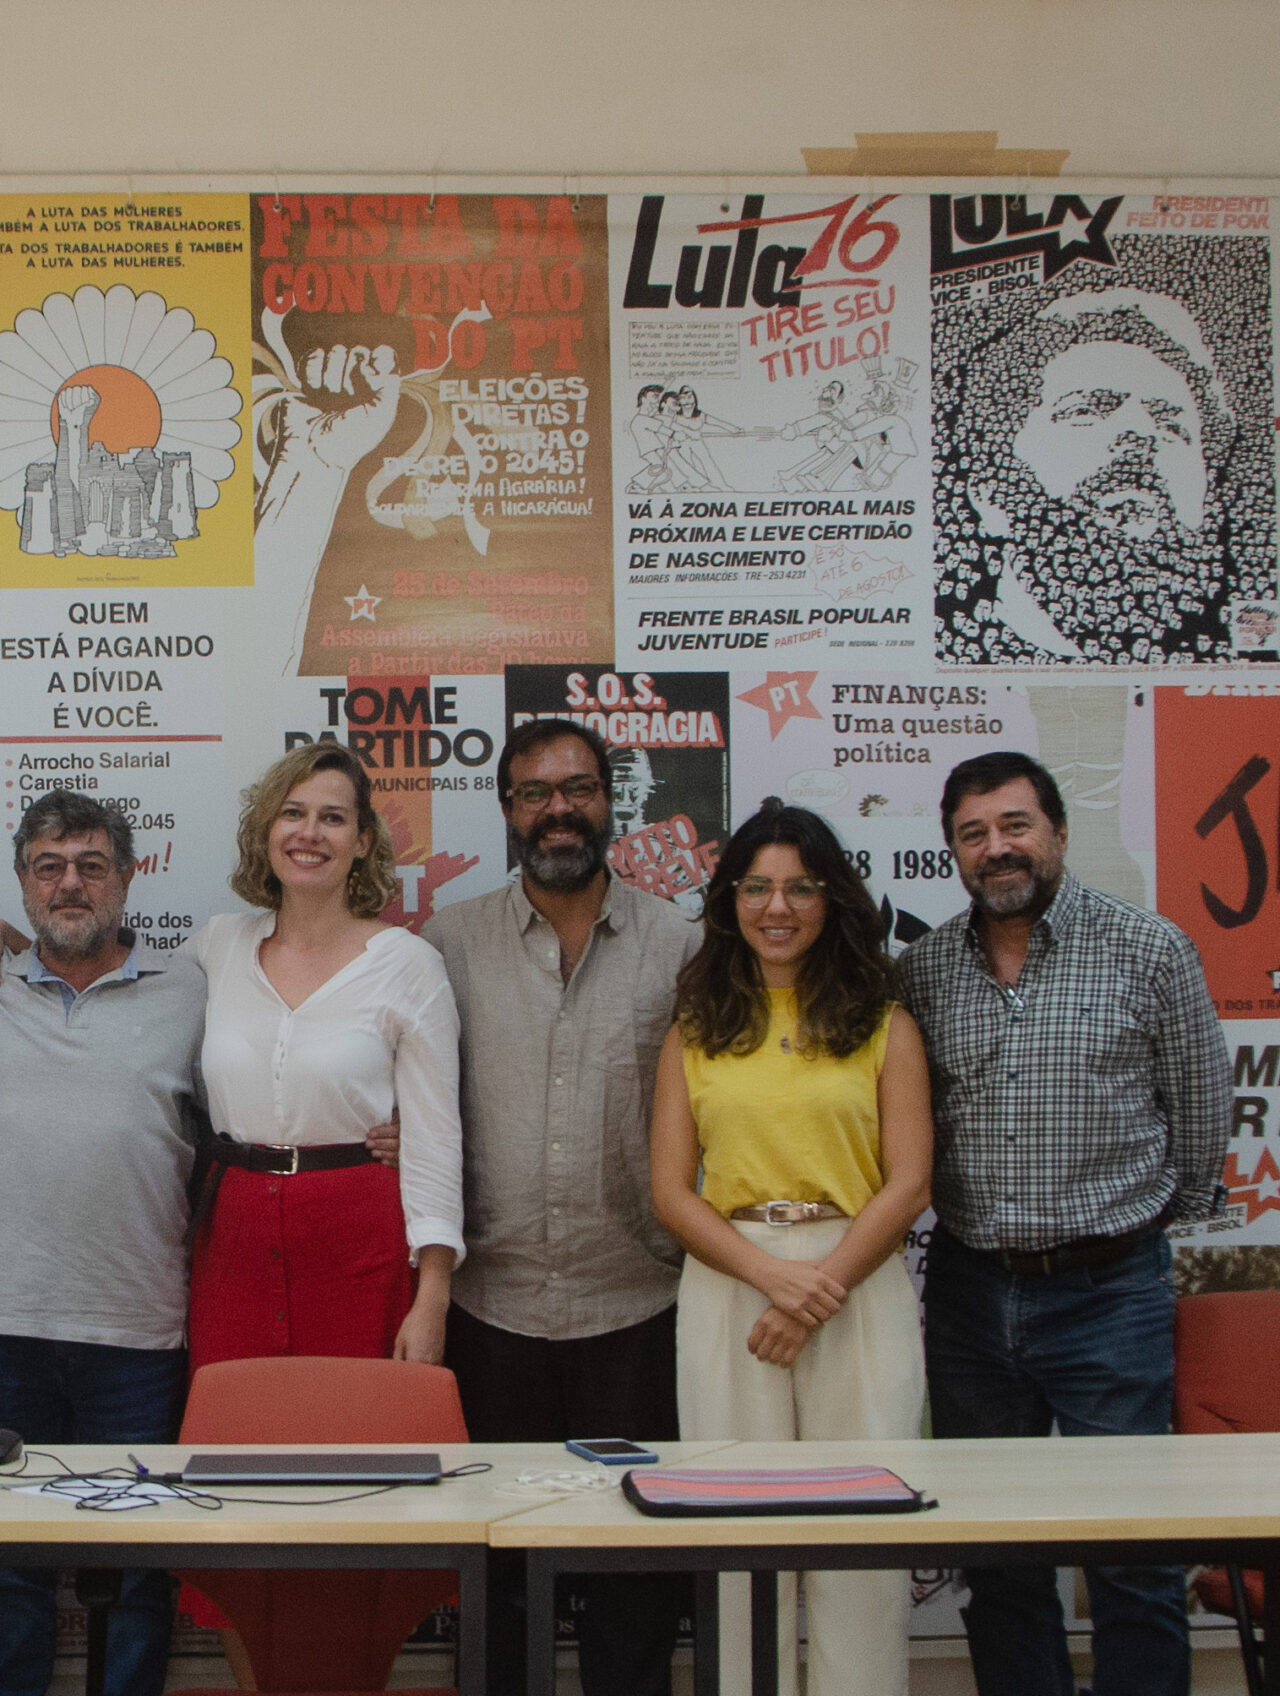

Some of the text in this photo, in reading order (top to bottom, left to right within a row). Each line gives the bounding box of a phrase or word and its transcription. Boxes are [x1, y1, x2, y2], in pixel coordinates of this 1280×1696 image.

[27, 206, 182, 218] A LUTA DAS MULHERES
[1126, 212, 1219, 229] FEITO DE
[40, 221, 49, 232] A
[54, 221, 86, 232] LUTA
[94, 220, 121, 232] DOS
[128, 220, 245, 232] TRABALHADORES.
[258, 194, 584, 257] FESTA DA
[20, 243, 48, 254] DOS
[56, 242, 169, 254] TRABALHADORES
[176, 239, 183, 253] É
[189, 240, 244, 253] TAMBÉM
[623, 195, 807, 309] Lula
[26, 256, 185, 268] A LUTA DAS MULHERES.
[930, 255, 1040, 290] PRESIDENTE
[263, 256, 585, 317] CONVENÇÃO
[930, 272, 1040, 305] VICE BISOL
[740, 285, 896, 348] TIRE SEU
[413, 317, 486, 370] DO
[510, 317, 584, 371] PT
[759, 321, 891, 383] TÍTULO!
[439, 373, 589, 403] ELEIÇÕES
[472, 429, 589, 452] CONTRA O
[505, 450, 585, 475] 2045!
[482, 502, 495, 516] A
[628, 499, 916, 519] VÁ ZONA ELEITORAL MAIS
[628, 521, 913, 543] PRÓXIMA E LEVE CERTIDÃO
[629, 550, 806, 569] DE NASCIMENTO
[431, 570, 589, 596] de Setembro
[629, 574, 670, 585] MAIORES
[69, 602, 149, 625] QUEM
[638, 608, 912, 628] FRENTE BRASIL POPULAR
[0, 632, 214, 660] ESTÁ PAGANDO
[638, 633, 769, 651] JUVENTUDE
[448, 655, 488, 673] das
[47, 667, 163, 693] A DÍVIDA
[320, 686, 458, 726] TOME
[770, 680, 802, 712] PT
[832, 684, 987, 711] FINANÇAS:
[53, 702, 158, 728] É VOCÊ.
[833, 713, 1003, 739] Uma questão
[513, 711, 724, 747] OCRACIA
[18, 751, 170, 770] Arrocho Salarial
[833, 741, 931, 767] política
[19, 774, 99, 791] Carestia
[473, 776, 495, 790] 88
[892, 850, 953, 879] 1988
[1207, 1218, 1243, 1232] BISOL
